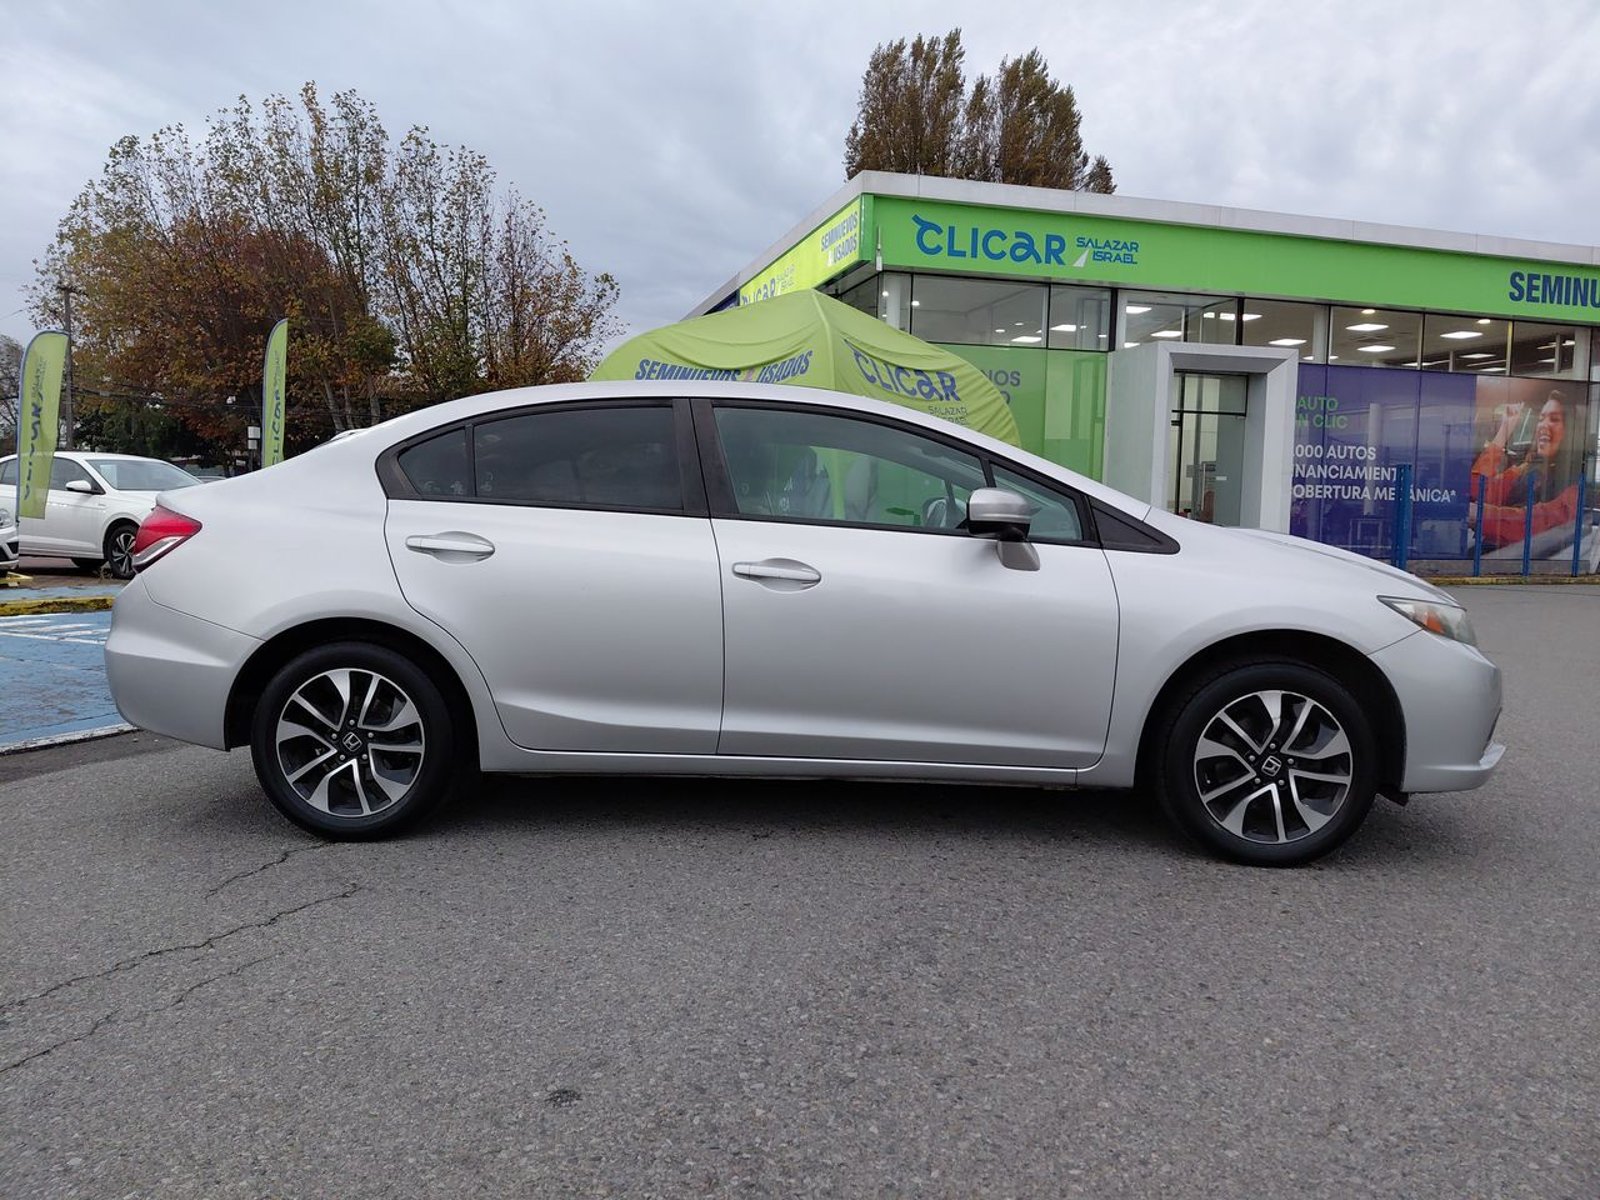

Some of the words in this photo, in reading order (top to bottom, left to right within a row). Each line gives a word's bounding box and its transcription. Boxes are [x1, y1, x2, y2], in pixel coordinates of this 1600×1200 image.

[1076, 236, 1140, 253] SALAZAR
[1092, 251, 1138, 265] ISRAEL
[1508, 270, 1600, 309] SEMINU
[928, 405, 968, 417] SALAZAR
[1297, 396, 1339, 412] AUTO
[1313, 414, 1349, 430] CLIC
[1326, 445, 1377, 461] AUTOS
[1295, 464, 1404, 481] NANCIAMIENT
[1374, 484, 1457, 504] MEÁNICA
